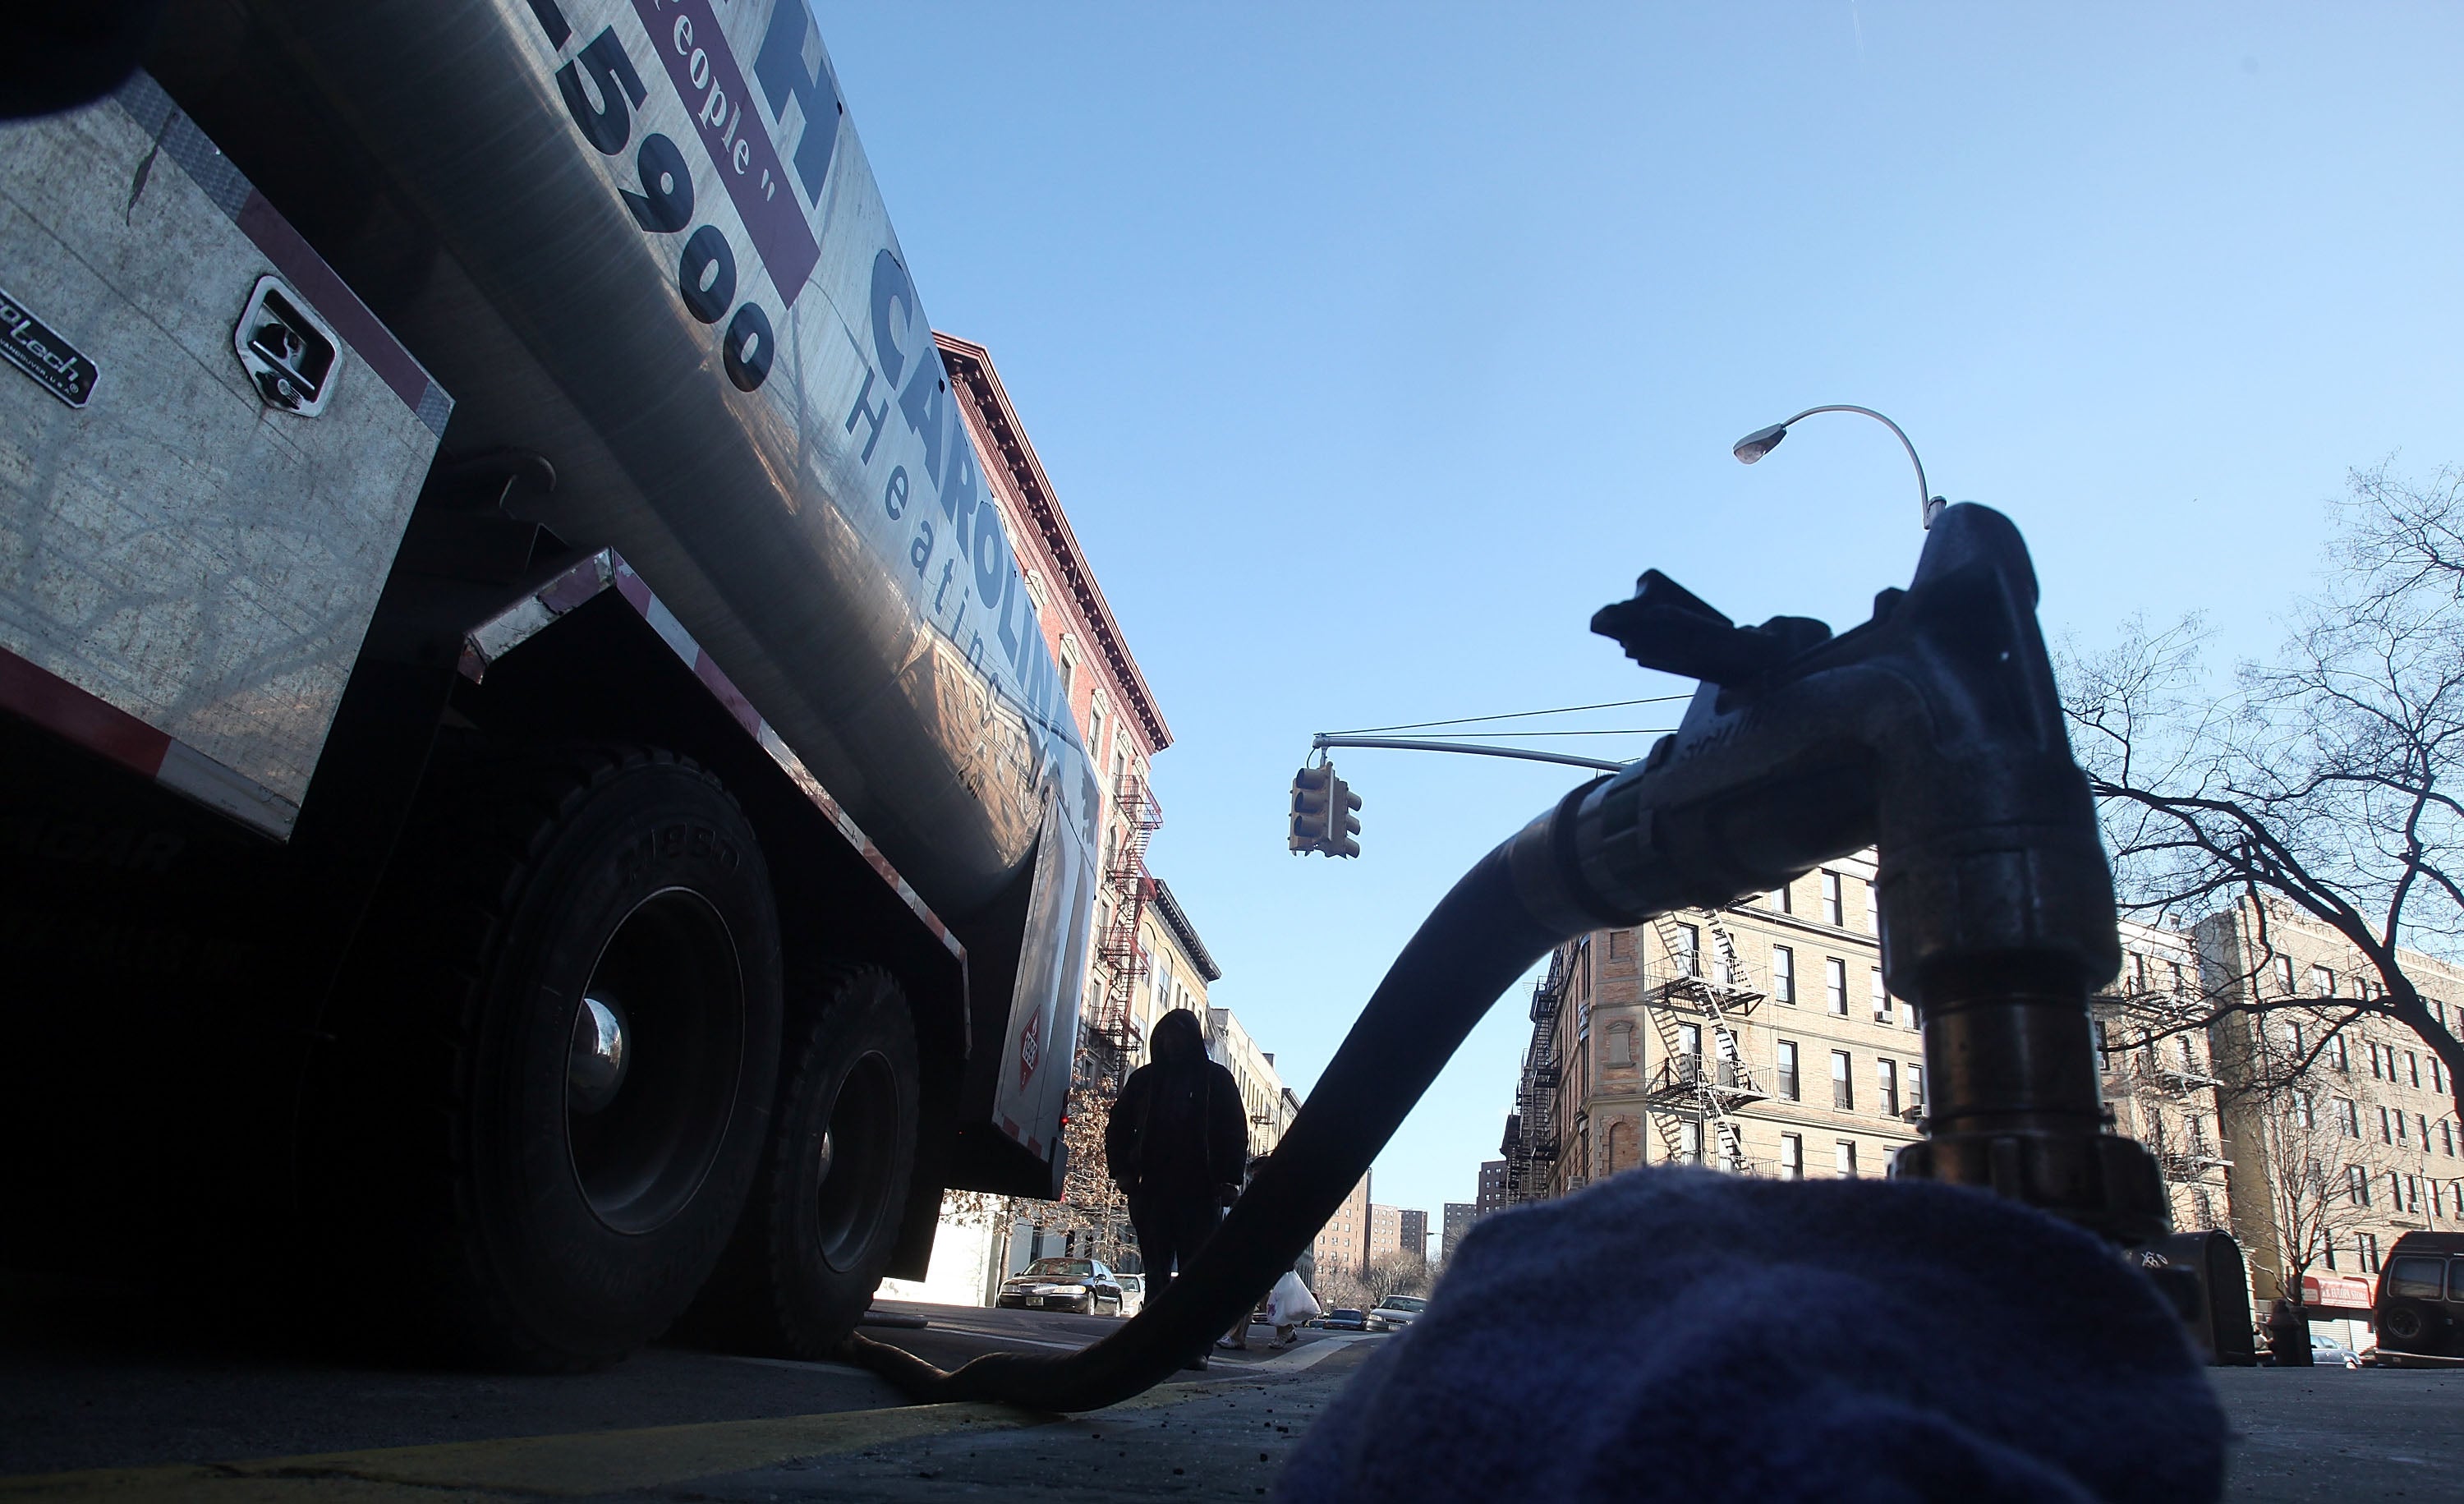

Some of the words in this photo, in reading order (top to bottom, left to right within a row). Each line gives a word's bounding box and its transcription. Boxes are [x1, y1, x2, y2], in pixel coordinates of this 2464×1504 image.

[655, 0, 750, 175] eople
[845, 366, 1003, 728] Heating
[871, 248, 1069, 780] CAROLINA
